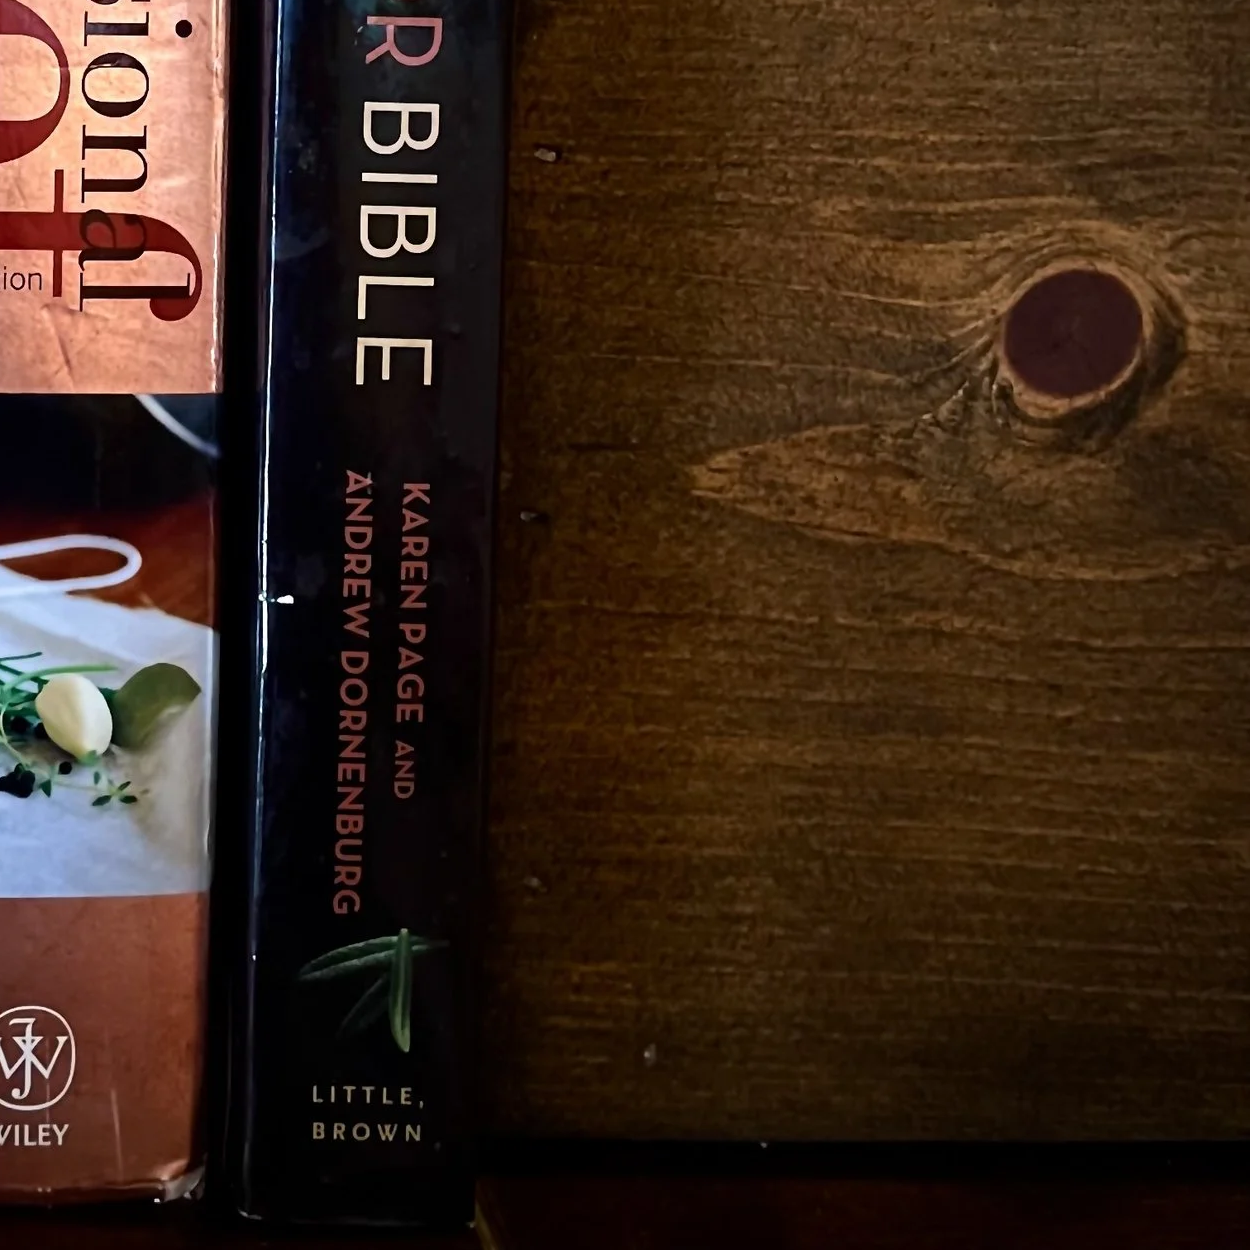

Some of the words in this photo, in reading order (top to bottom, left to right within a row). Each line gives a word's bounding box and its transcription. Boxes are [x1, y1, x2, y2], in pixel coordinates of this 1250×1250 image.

[355, 101, 440, 385] BIBLE
[341, 469, 373, 638] ANDREW
[400, 482, 431, 609] KAREN
[395, 622, 427, 723] PAGE
[332, 650, 369, 914] DORNENBURG
[393, 739, 415, 799] AND
[312, 1085, 424, 1109] LITTLE,
[312, 1122, 421, 1142] BROWN
